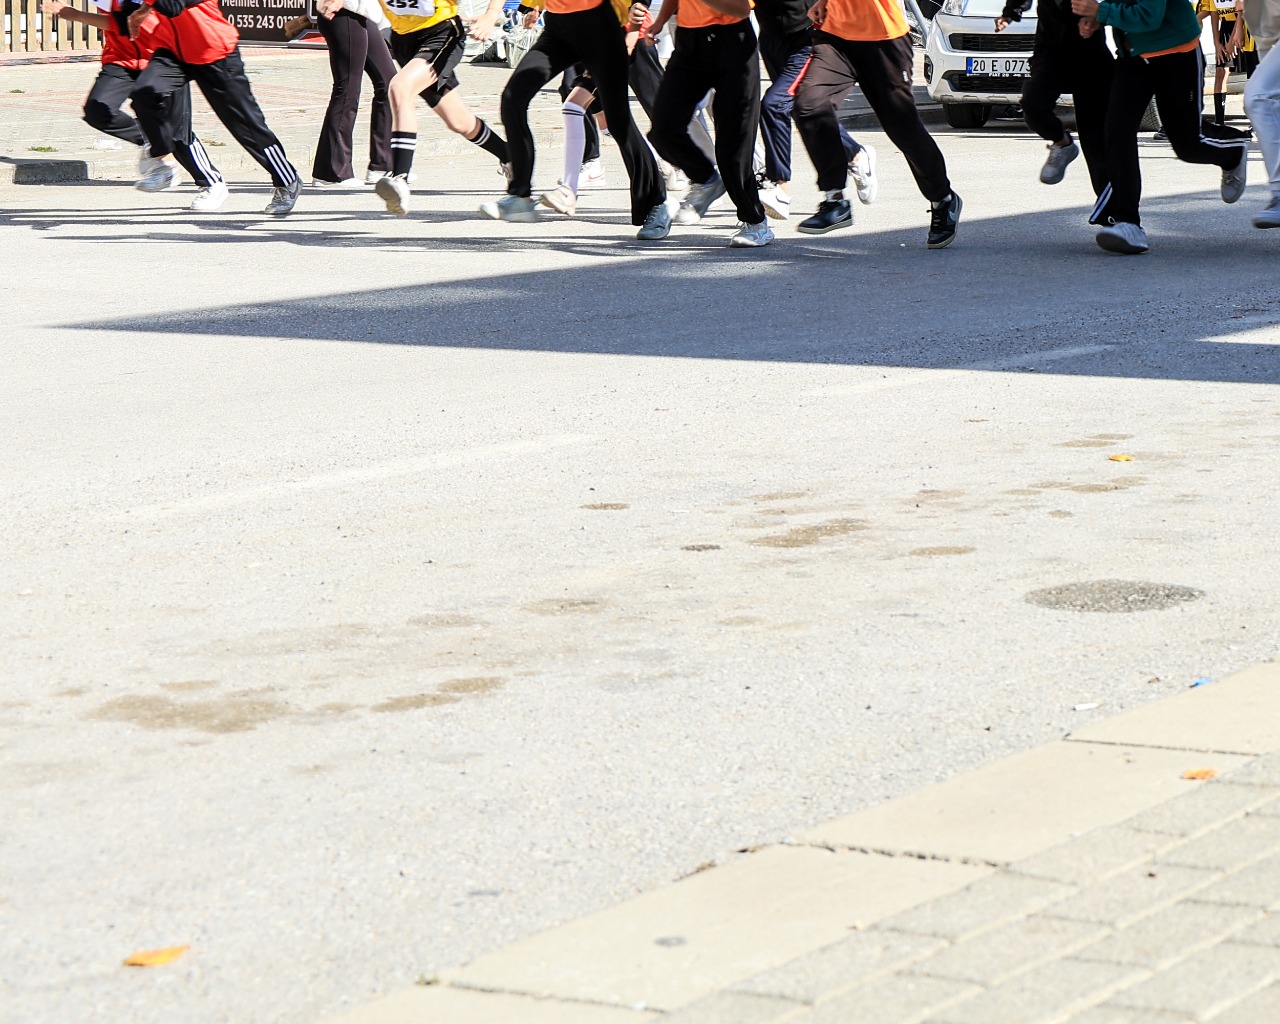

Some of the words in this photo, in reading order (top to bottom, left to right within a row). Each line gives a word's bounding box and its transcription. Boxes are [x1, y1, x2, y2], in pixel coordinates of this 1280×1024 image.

[236, 14, 254, 28] 535
[256, 15, 275, 29] 243
[973, 59, 986, 72] 20
[991, 60, 998, 72] E
